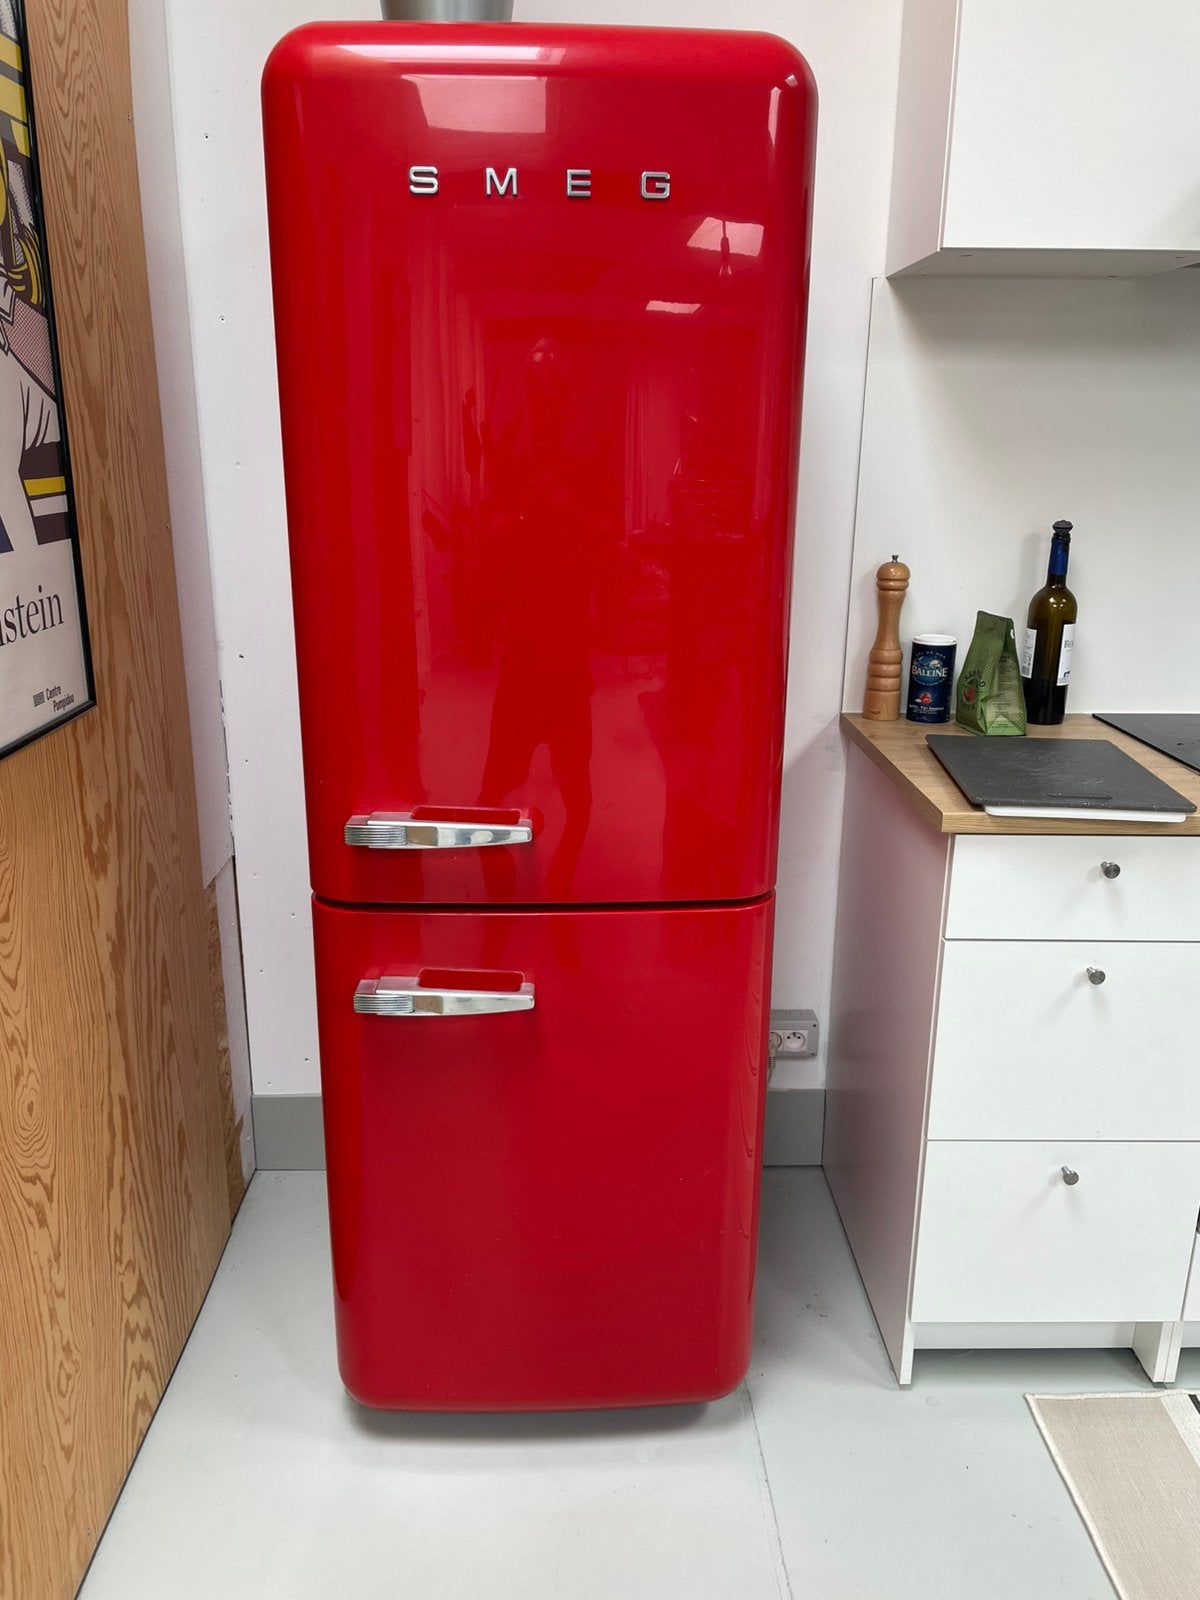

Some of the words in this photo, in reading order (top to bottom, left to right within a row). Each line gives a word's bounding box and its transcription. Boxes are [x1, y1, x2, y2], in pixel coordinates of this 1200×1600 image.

[409, 166, 671, 199] SMEG
[0, 585, 64, 646] stein
[912, 665, 948, 677] BALEINE
[46, 685, 61, 700] Centre
[53, 693, 75, 712] Pompidou
